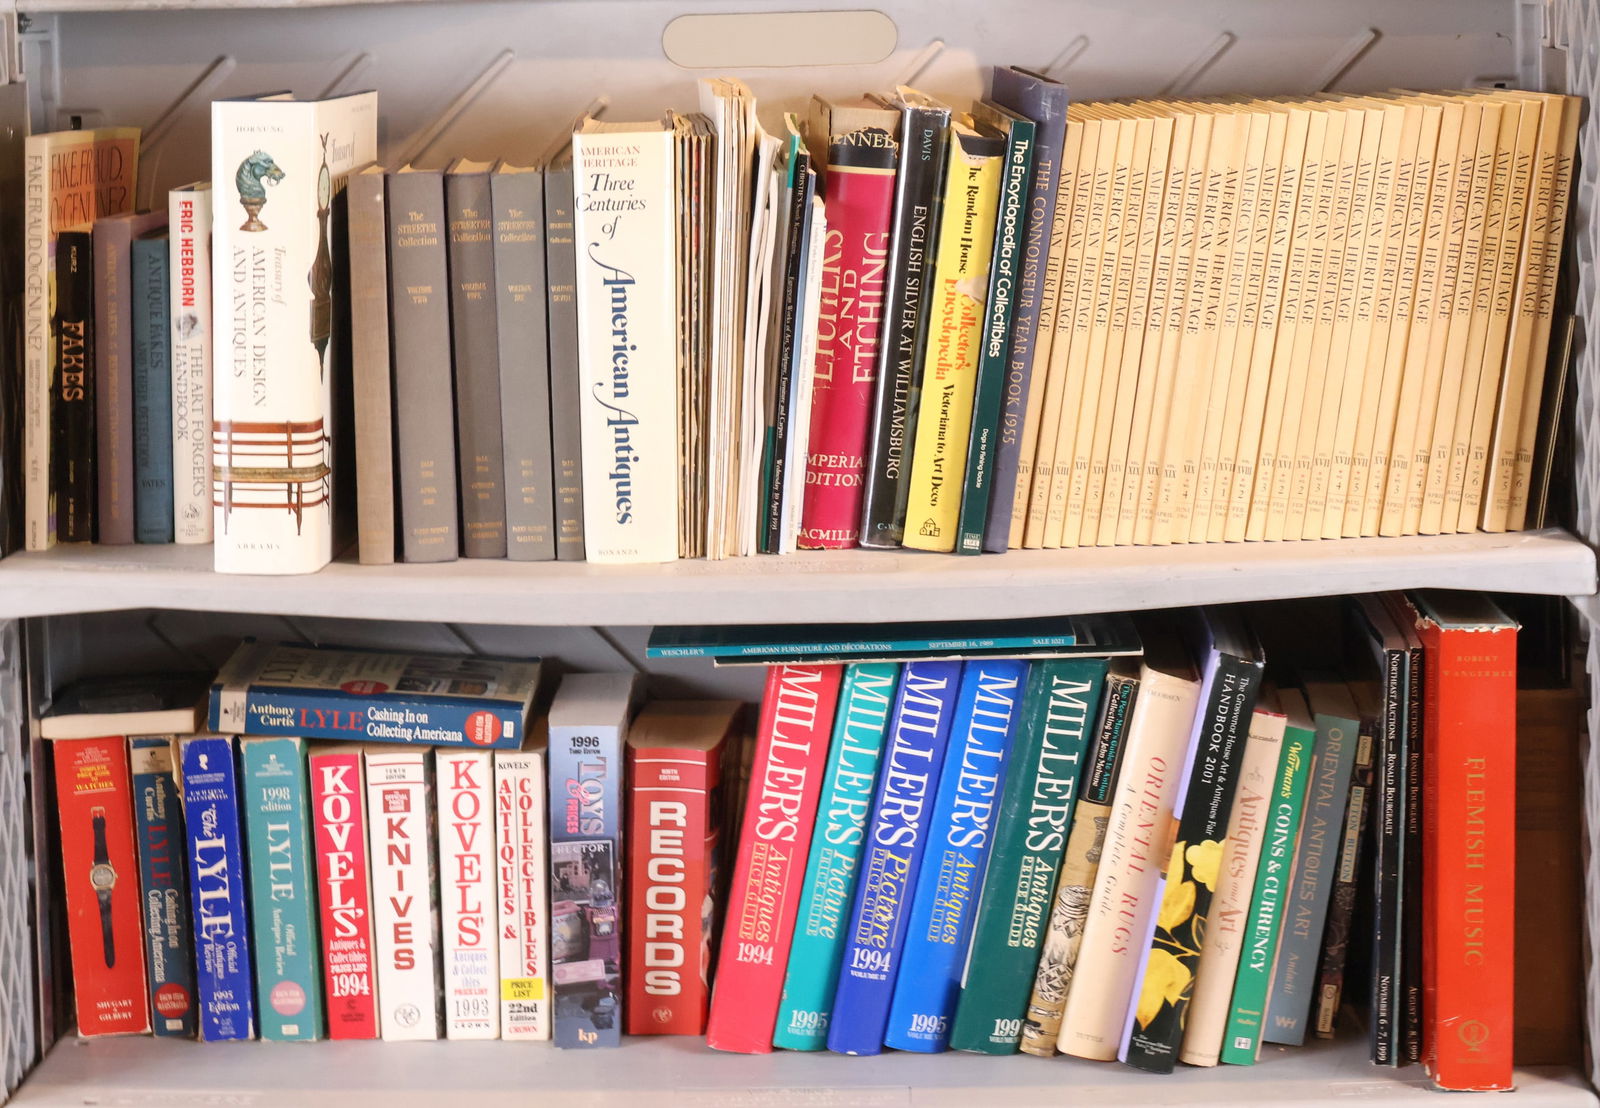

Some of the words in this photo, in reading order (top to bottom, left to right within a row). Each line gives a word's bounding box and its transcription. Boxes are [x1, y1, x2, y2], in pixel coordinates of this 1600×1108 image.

[235, 125, 284, 134] HORNUNG
[580, 145, 641, 156] AMERICAN
[921, 129, 934, 160] DAVIS
[1013, 139, 1029, 165] The
[582, 158, 638, 168] HERITAGE
[590, 173, 635, 192] Three
[1035, 160, 1053, 192] THE
[575, 193, 647, 212] Centuries
[963, 185, 980, 235] Random
[1000, 165, 1026, 258] Encyclopedia
[1051, 170, 1072, 247] AMERICAN
[1124, 169, 1143, 248] AMERICAN
[1200, 170, 1220, 250] AMERICAN
[1274, 165, 1295, 245] AMERICAN
[1350, 160, 1372, 239] AMERICAN
[1429, 160, 1450, 240] AMERICAN
[1508, 151, 1530, 232] AMERICAN
[179, 200, 195, 233] ERIC
[601, 215, 622, 240] of
[907, 205, 928, 272] ENGLISH
[70, 245, 78, 273] KURZ
[180, 238, 196, 307] HEBBORN
[233, 244, 247, 283] AND
[958, 237, 973, 274] House
[999, 259, 1014, 276] of
[1019, 196, 1047, 308] CONNOISSEUR
[147, 255, 164, 317] ANTIQUE
[252, 245, 267, 337] AMERICAN
[1039, 257, 1059, 332] HERITAGE
[1113, 256, 1132, 332] HERITAGE
[1187, 258, 1208, 334] HERITAGE
[1261, 253, 1282, 330] HERITAGE
[1338, 247, 1358, 322] HERITAGE
[1416, 247, 1437, 324] HERITAGE
[1496, 240, 1516, 316] HERITAGE
[588, 242, 638, 399] American
[840, 269, 857, 353] AND
[901, 277, 920, 330] SILVER
[988, 277, 1012, 358] Collectibles
[149, 319, 165, 369] FAKES
[232, 285, 247, 378] ANTIQUES
[899, 334, 914, 355] AT
[934, 278, 958, 380] Encyclopedia
[954, 294, 977, 371] Collector's
[1013, 314, 1033, 355] YEAR
[61, 319, 84, 401] FAKES
[190, 344, 204, 377] THE
[252, 344, 267, 407] DESIGN
[1006, 360, 1025, 407] BOOK
[175, 343, 190, 441] HANDBOOK
[191, 381, 204, 414] ART
[936, 383, 955, 441] Victoriana
[885, 359, 911, 480] WILLIAMSBURG
[1001, 412, 1019, 446] 1955
[192, 419, 207, 498] FORGER'S
[592, 382, 640, 525] Antiques
[933, 454, 945, 473] Art
[936, 442, 946, 454] to
[929, 476, 944, 507] Deco
[660, 648, 705, 657] WESCHLER'S
[1238, 677, 1250, 692] The
[248, 703, 296, 716] Anthony
[260, 714, 295, 727] Curtis
[299, 708, 365, 731] LYLE
[366, 723, 413, 741] Collecting
[413, 728, 463, 742] Americana
[367, 706, 405, 723] Cashing
[405, 710, 416, 722] In
[416, 713, 429, 723] on
[1104, 693, 1120, 730] Collecting
[1208, 673, 1236, 752] HANDBOOK
[1228, 693, 1246, 733] Grosvenor
[570, 736, 600, 748] 1996
[755, 665, 822, 842] MILLER'S
[824, 669, 894, 845] MILLER'S
[875, 670, 948, 849] MILLER'S
[947, 670, 1019, 849] MILLER'S
[1098, 741, 1109, 759] John
[1101, 731, 1113, 742] by
[1222, 735, 1237, 760] House
[1023, 674, 1092, 852] MILLER'S
[1201, 756, 1217, 784] 2001
[1217, 776, 1227, 784] &
[1219, 761, 1230, 775] Art
[1280, 741, 1303, 799] Warman's
[1315, 727, 1344, 812] ORIENTAL
[144, 786, 156, 822] Curtis
[260, 803, 292, 812] edition
[262, 786, 291, 801] 1998
[580, 756, 608, 835] TOYS
[1126, 783, 1136, 793] A
[1208, 784, 1225, 820] Antiques
[1348, 787, 1362, 832] BUTTON
[566, 798, 579, 834] PRICES
[1108, 803, 1133, 867] Complete
[1126, 757, 1168, 876] ORIENTAL
[1205, 820, 1217, 835] Fair
[1229, 785, 1265, 879] Antiques
[1270, 803, 1293, 858] COINS
[1463, 756, 1486, 869] FLEMISH
[147, 825, 173, 887] LYLE
[266, 821, 295, 902] LYLE
[320, 765, 365, 938] KOVELS'
[449, 760, 484, 947] KOVELS'
[747, 841, 768, 891] PRICE
[815, 847, 834, 888] PRICE
[866, 847, 889, 893] PRICE
[936, 850, 956, 892] PRICE
[1266, 859, 1282, 874] &
[1299, 816, 1327, 901] ANTIQUES
[1342, 838, 1356, 881] BUTTON
[194, 833, 234, 941] LYLE
[387, 816, 415, 971] KNIVES
[519, 777, 538, 977] COLLECTIBLES
[645, 801, 688, 996] RECORDS
[755, 845, 788, 943] Antiques
[819, 850, 856, 939] Picture
[942, 854, 976, 945] Antiques
[1016, 855, 1034, 897] PRICE
[1100, 876, 1117, 919] Guide
[1230, 880, 1241, 901] and
[147, 889, 165, 935] Collecting
[739, 892, 758, 940] GUIDE
[806, 888, 825, 937] GUIDE
[855, 896, 875, 945] GUIDE
[869, 852, 911, 949] Picture
[927, 897, 947, 943] GUIDE
[1007, 902, 1029, 947] GUIDE
[1021, 856, 1054, 948] Antiques
[1111, 892, 1141, 956] RUGS
[1219, 899, 1242, 933] Art
[1249, 876, 1281, 973] CURRENCY
[1293, 904, 1313, 940] ART
[1463, 884, 1484, 966] MUSIC
[151, 935, 167, 983] Americana
[735, 942, 774, 966] 1994
[849, 947, 892, 973] 1994
[1283, 952, 1300, 996] Andacht
[331, 973, 370, 997] 1994
[455, 998, 489, 1018] 1993
[508, 1002, 538, 1013] 22nd
[513, 989, 532, 998] LIST
[508, 1024, 538, 1034] CROWN
[577, 1028, 598, 1045] kp
[789, 1009, 828, 1030] 1995
[908, 1013, 947, 1033] 1995
